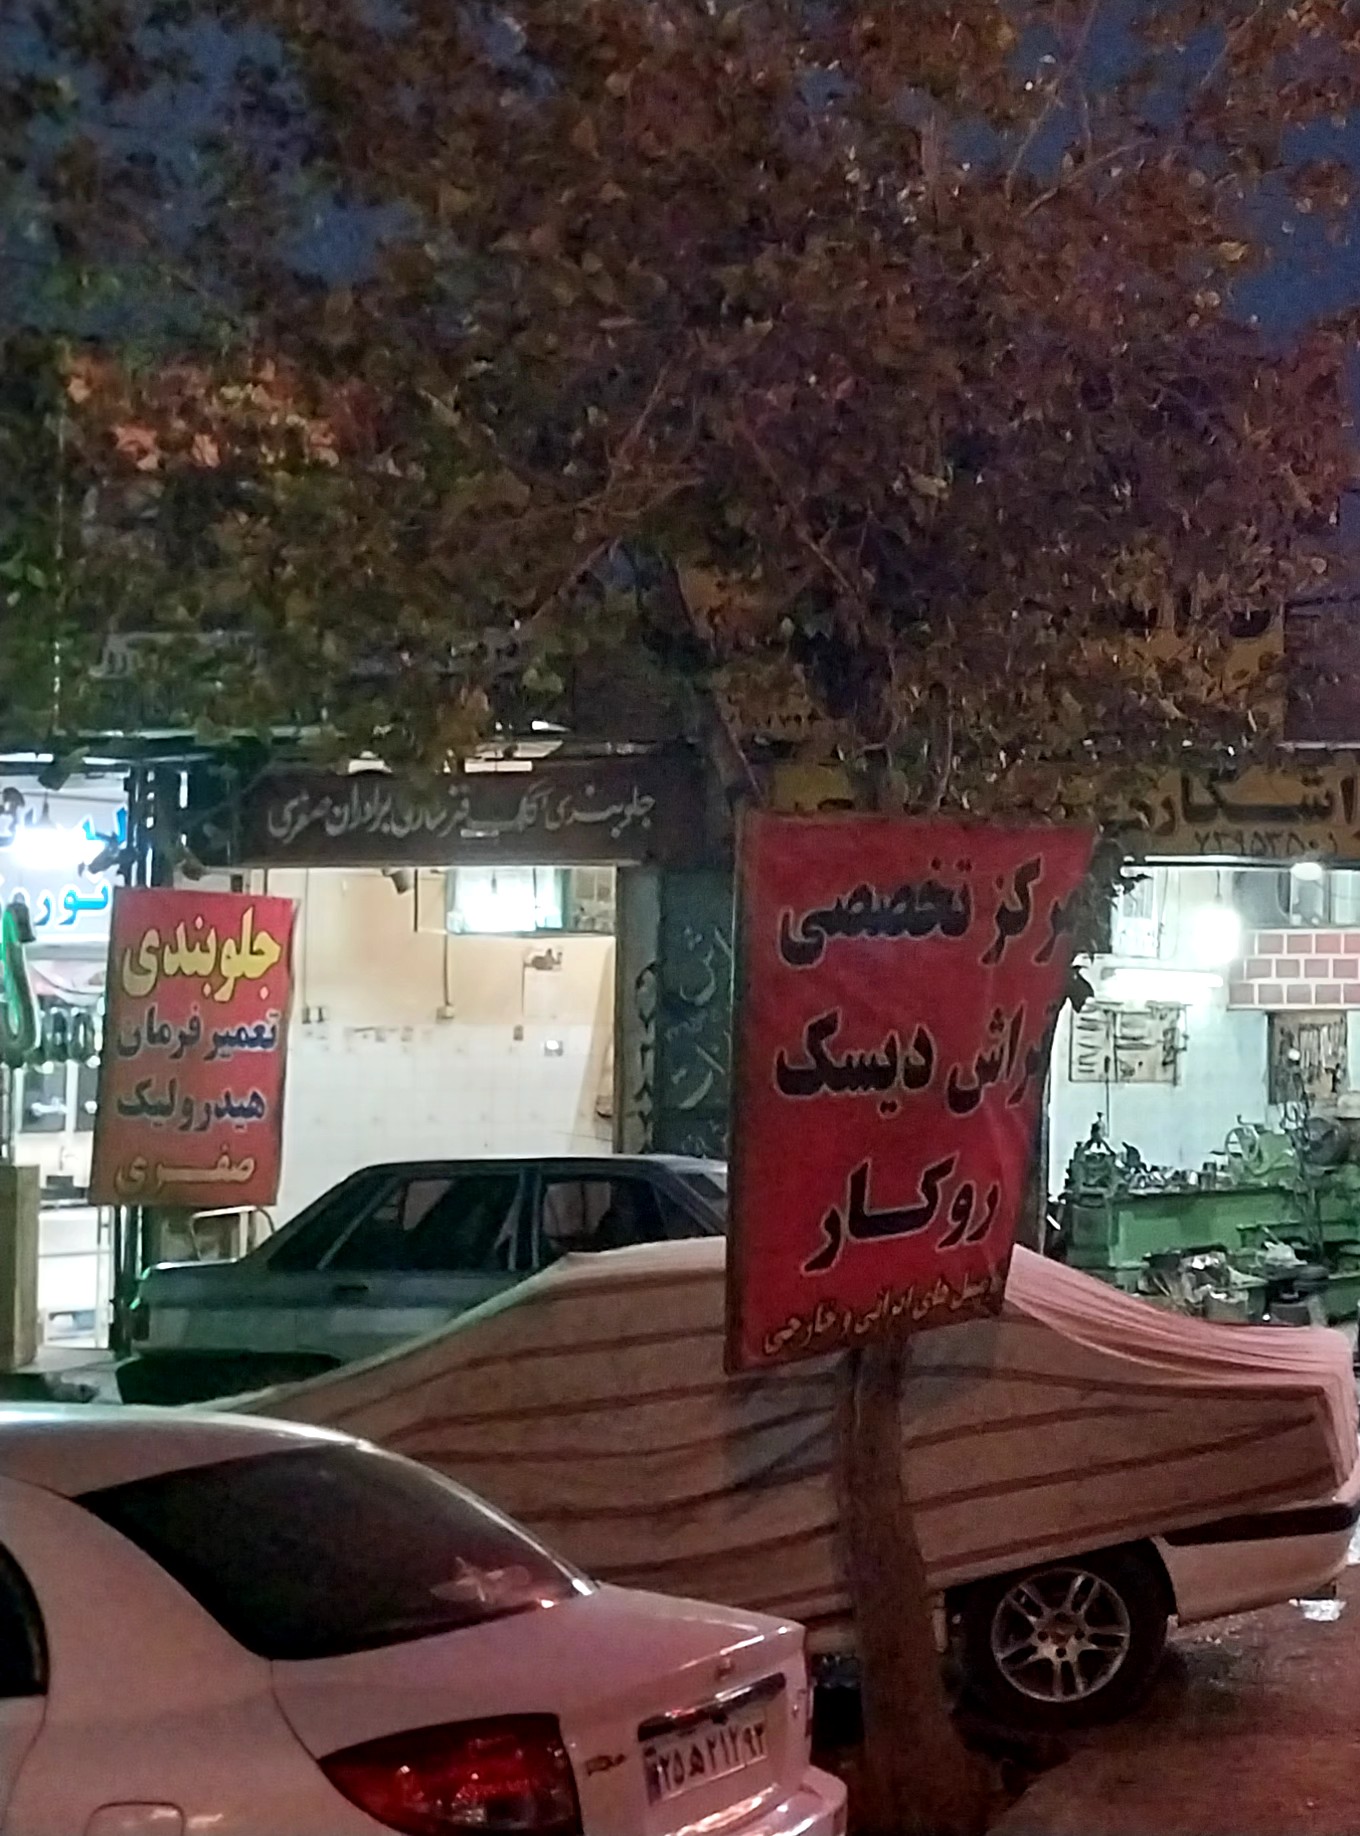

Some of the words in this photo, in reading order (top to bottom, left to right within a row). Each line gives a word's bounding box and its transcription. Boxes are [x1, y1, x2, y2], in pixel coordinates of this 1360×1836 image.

[545, 784, 657, 838] جلوبندی
[778, 857, 975, 970] تخصصی
[122, 908, 281, 1003] جلوبندی
[116, 1005, 203, 1061] فرمان
[204, 1008, 278, 1062] تعمیر
[774, 1006, 938, 1119] دیسک
[116, 1077, 267, 1134] هیدرولیک
[114, 1144, 257, 1191] صفری
[802, 1152, 1002, 1275] روکار
